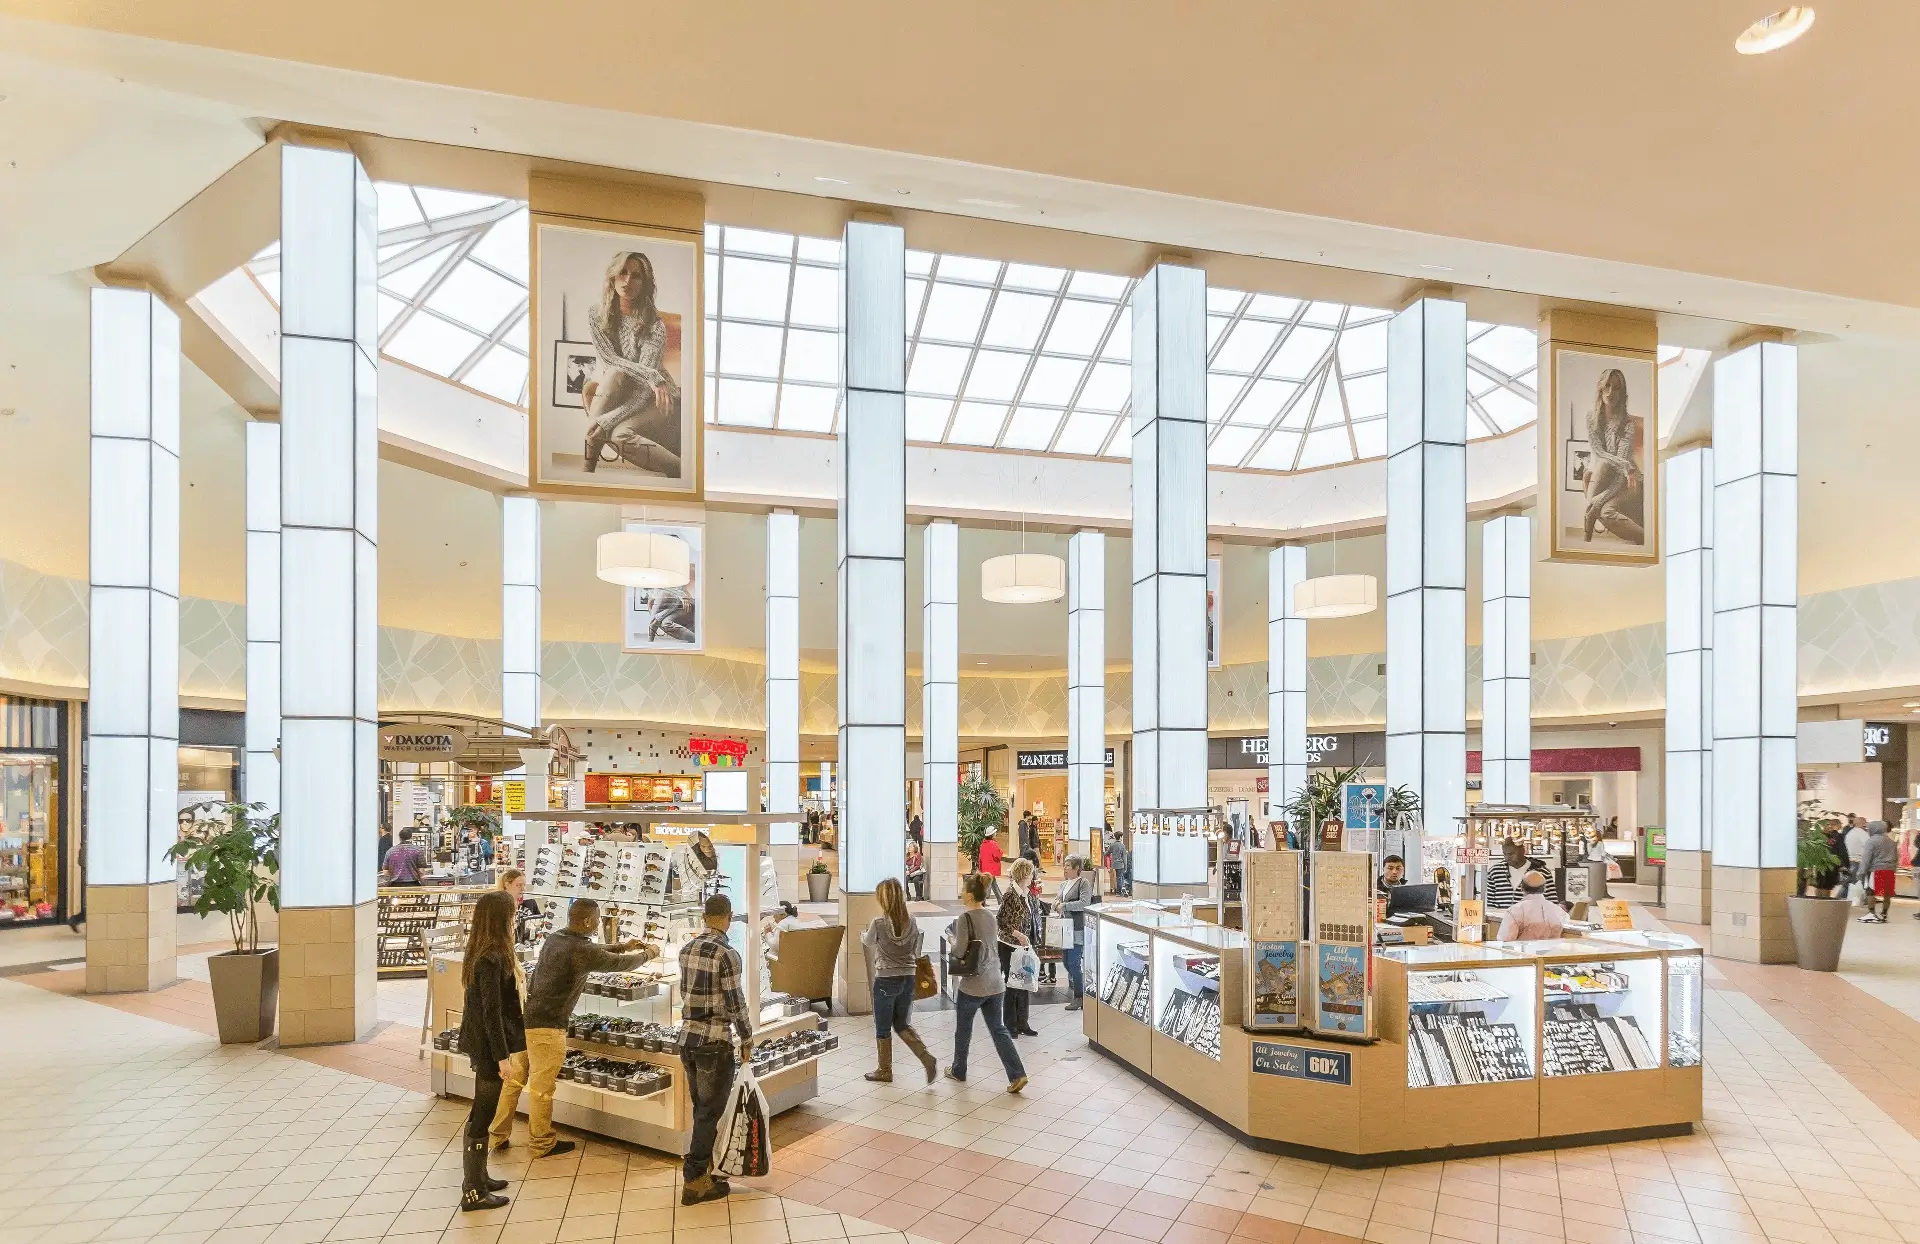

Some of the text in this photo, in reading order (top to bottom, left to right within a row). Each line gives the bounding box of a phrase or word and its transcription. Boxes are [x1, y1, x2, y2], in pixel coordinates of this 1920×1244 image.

[396, 735, 452, 745] DAKOTA
[1241, 736, 1338, 754] HEERG
[1019, 754, 1064, 766] YANKEE
[1465, 908, 1478, 916] Now
[1264, 950, 1294, 960] Jewelry
[1325, 952, 1358, 966] Jewelry
[1255, 1045, 1298, 1059] All Jewelry
[1255, 1057, 1299, 1072] On Sale:
[1309, 1056, 1339, 1076] 60%
